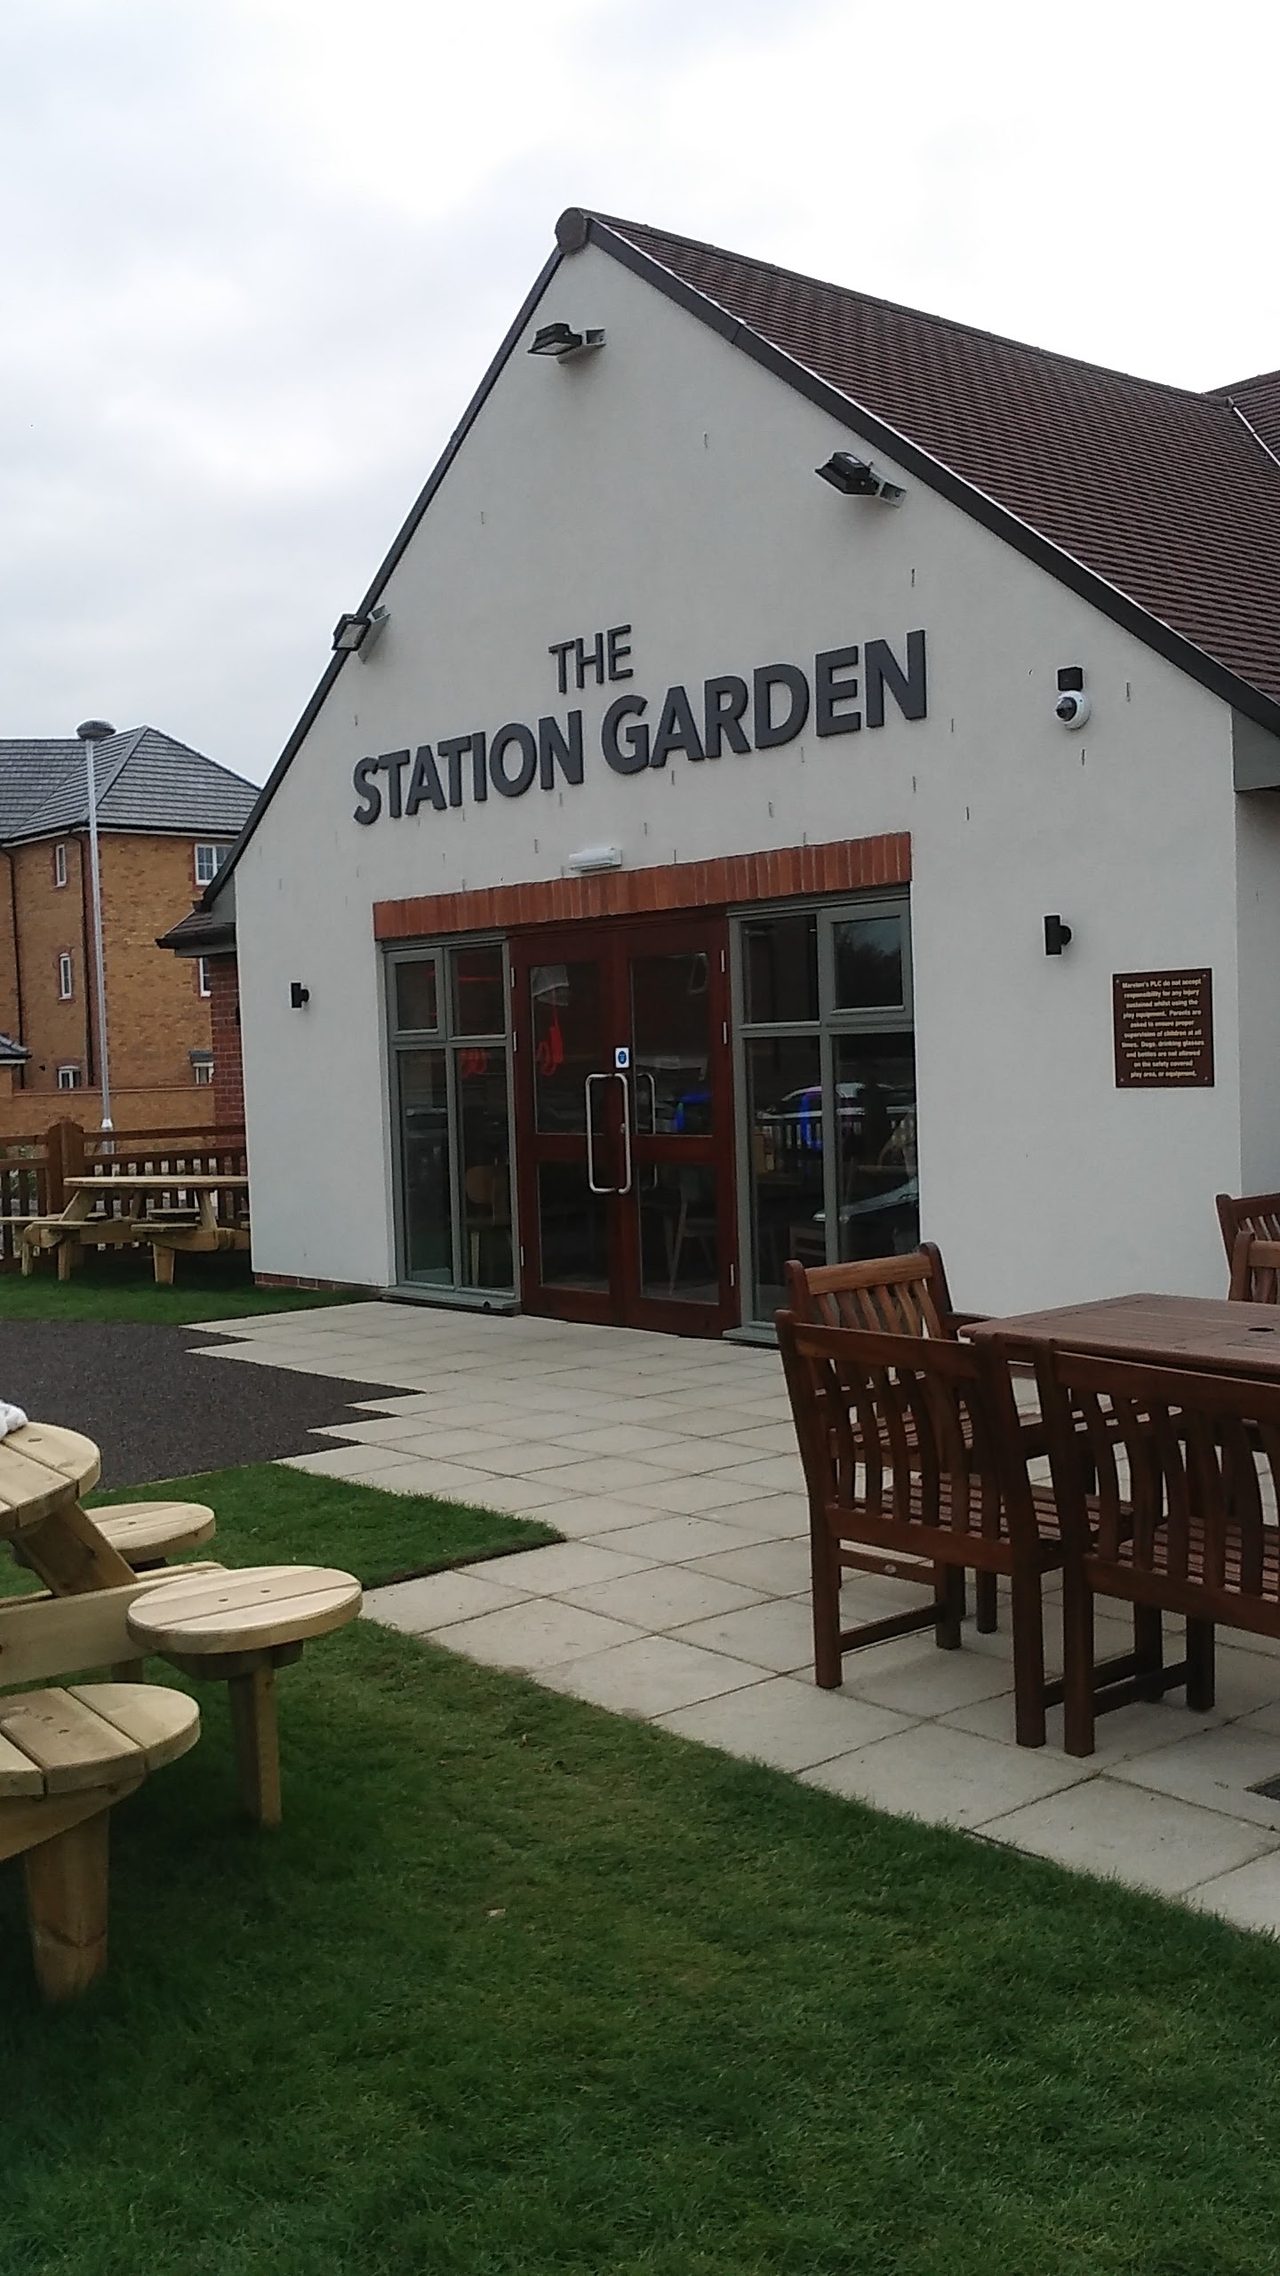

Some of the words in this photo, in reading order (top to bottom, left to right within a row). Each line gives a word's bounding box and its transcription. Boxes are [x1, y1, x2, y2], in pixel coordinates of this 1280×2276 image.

[548, 624, 633, 694] THE
[353, 709, 584, 825] STATION
[600, 629, 927, 775] GARDEN
